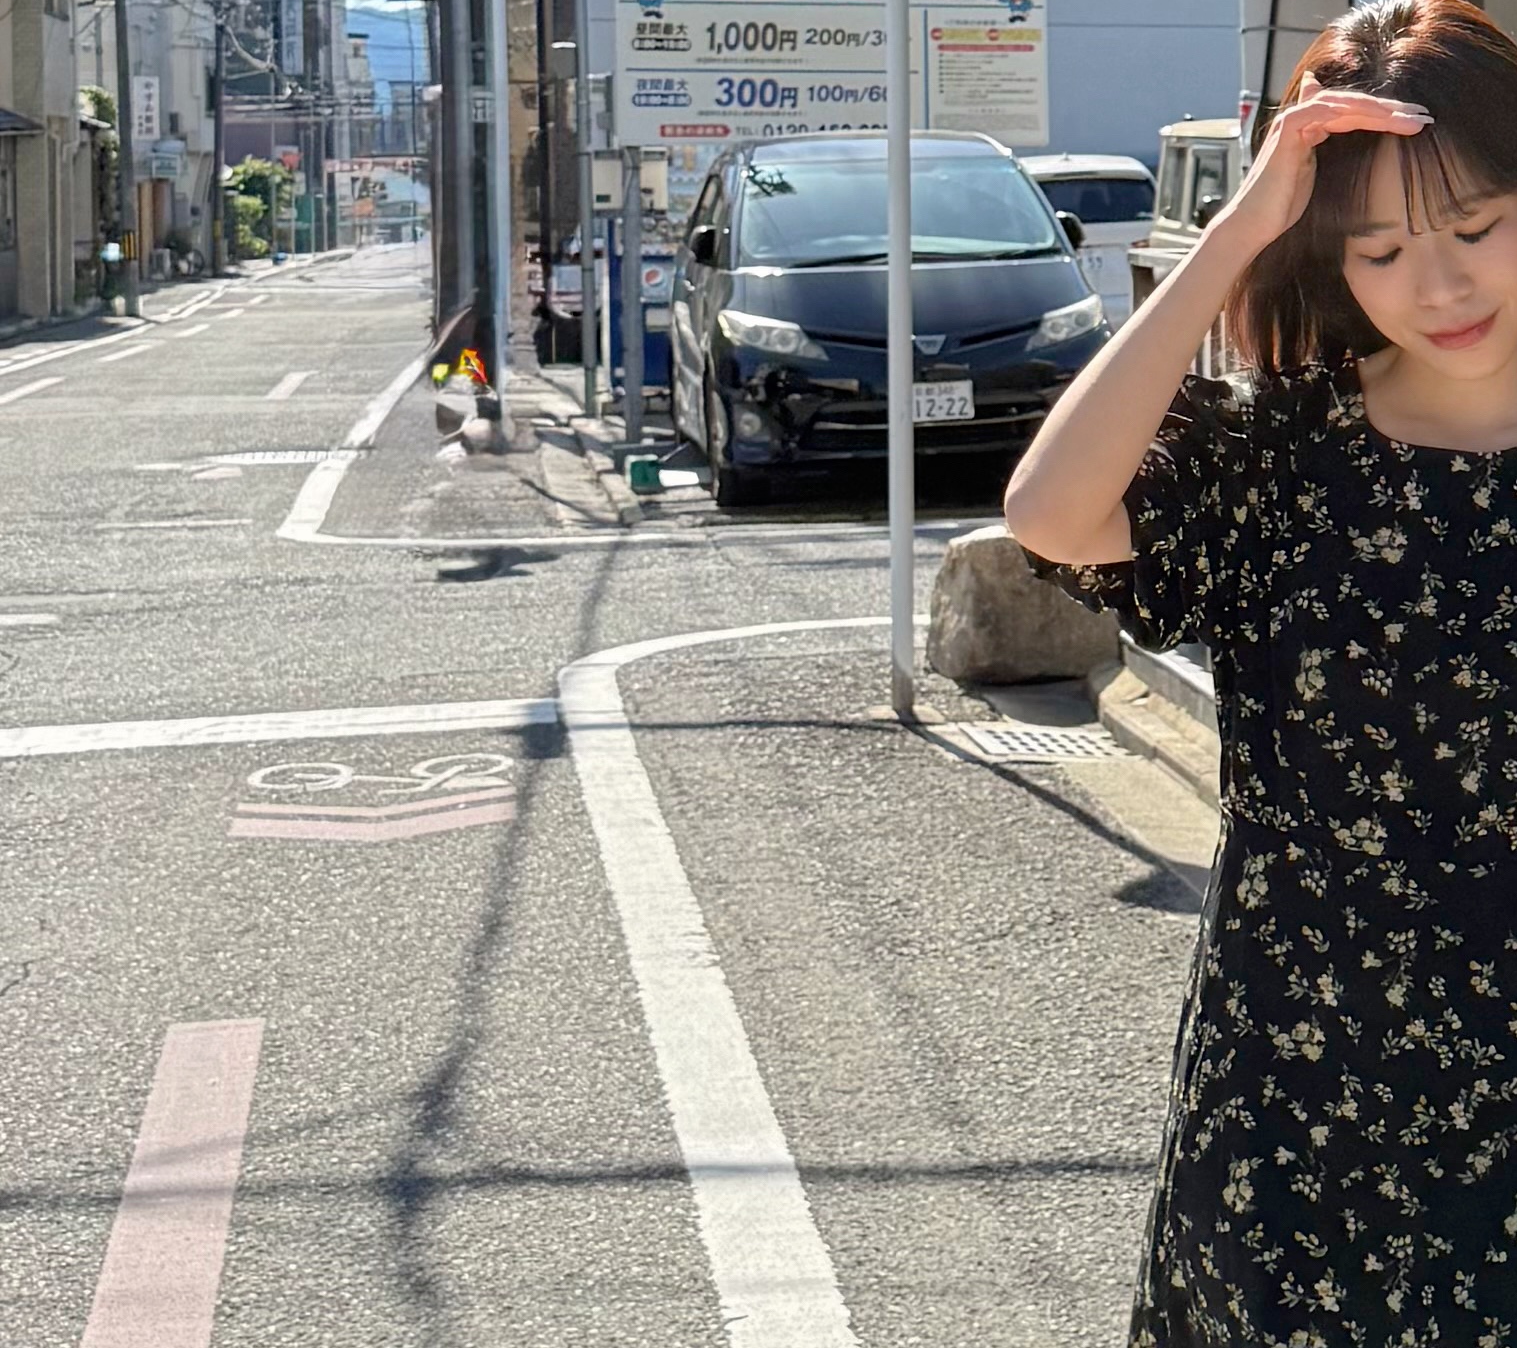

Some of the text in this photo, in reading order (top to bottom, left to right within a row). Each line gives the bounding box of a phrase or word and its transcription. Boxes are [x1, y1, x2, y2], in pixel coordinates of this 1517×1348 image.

[706, 21, 888, 55] 1,000円 200円/3
[715, 77, 799, 109] 300円
